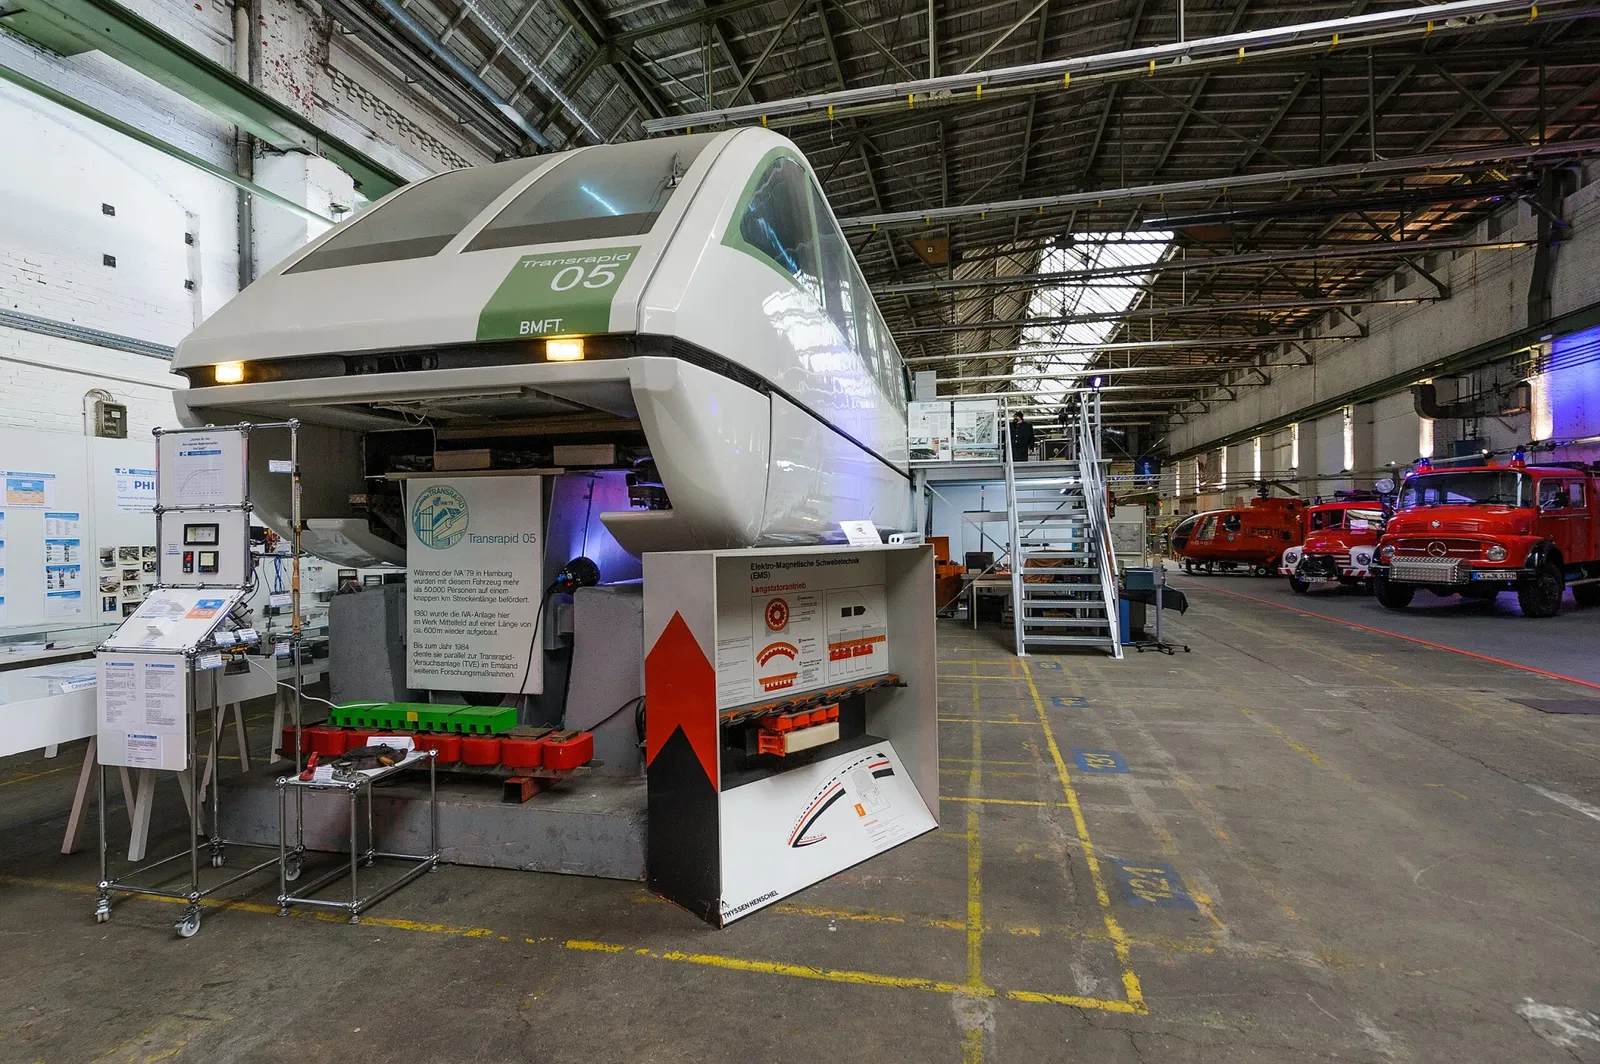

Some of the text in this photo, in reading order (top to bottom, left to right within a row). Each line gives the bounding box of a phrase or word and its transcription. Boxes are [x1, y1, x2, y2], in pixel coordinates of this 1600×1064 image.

[522, 252, 632, 268] Transrapid
[550, 263, 620, 292] 05
[519, 318, 565, 335] BMFT.
[427, 487, 465, 509] TRANSRAPID
[467, 533, 537, 545] Transrapid 05
[750, 557, 860, 571] Elektro-Magnetische Schwebetechnik
[413, 569, 441, 577] Während
[441, 569, 452, 577] der
[483, 570, 513, 578] Hamburg
[750, 572, 771, 581] (EMS)
[472, 578, 502, 587] Fahrzeug
[503, 578, 520, 586] mehr
[751, 582, 807, 594] Langstatorantrieb
[447, 586, 477, 594] Personen
[478, 586, 489, 594] auf
[413, 594, 440, 602] knappen
[452, 594, 497, 604] Streckenlänge
[498, 595, 530, 604] befördert.
[413, 609, 428, 617] 1980
[450, 610, 460, 618] die
[497, 611, 511, 619] hier
[421, 618, 438, 626] Werk
[439, 619, 467, 627] Mittelfeld
[468, 619, 479, 627] auf
[498, 620, 519, 629] Länge
[444, 627, 465, 635] wieder
[466, 628, 500, 637] aufgebaut.
[413, 641, 423, 649] Bis
[439, 642, 453, 650] Jahr
[454, 643, 470, 651] 1984
[444, 651, 467, 659] parallel
[467, 652, 478, 660] zur
[479, 652, 515, 662] Transrapid-
[413, 658, 518, 670] Versuchsanlage (TVE) im Emsland
[413, 667, 516, 678] weiteren Forschungsmaßnahmen.
[722, 889, 780, 919] THYSSEN HENSCHEL
